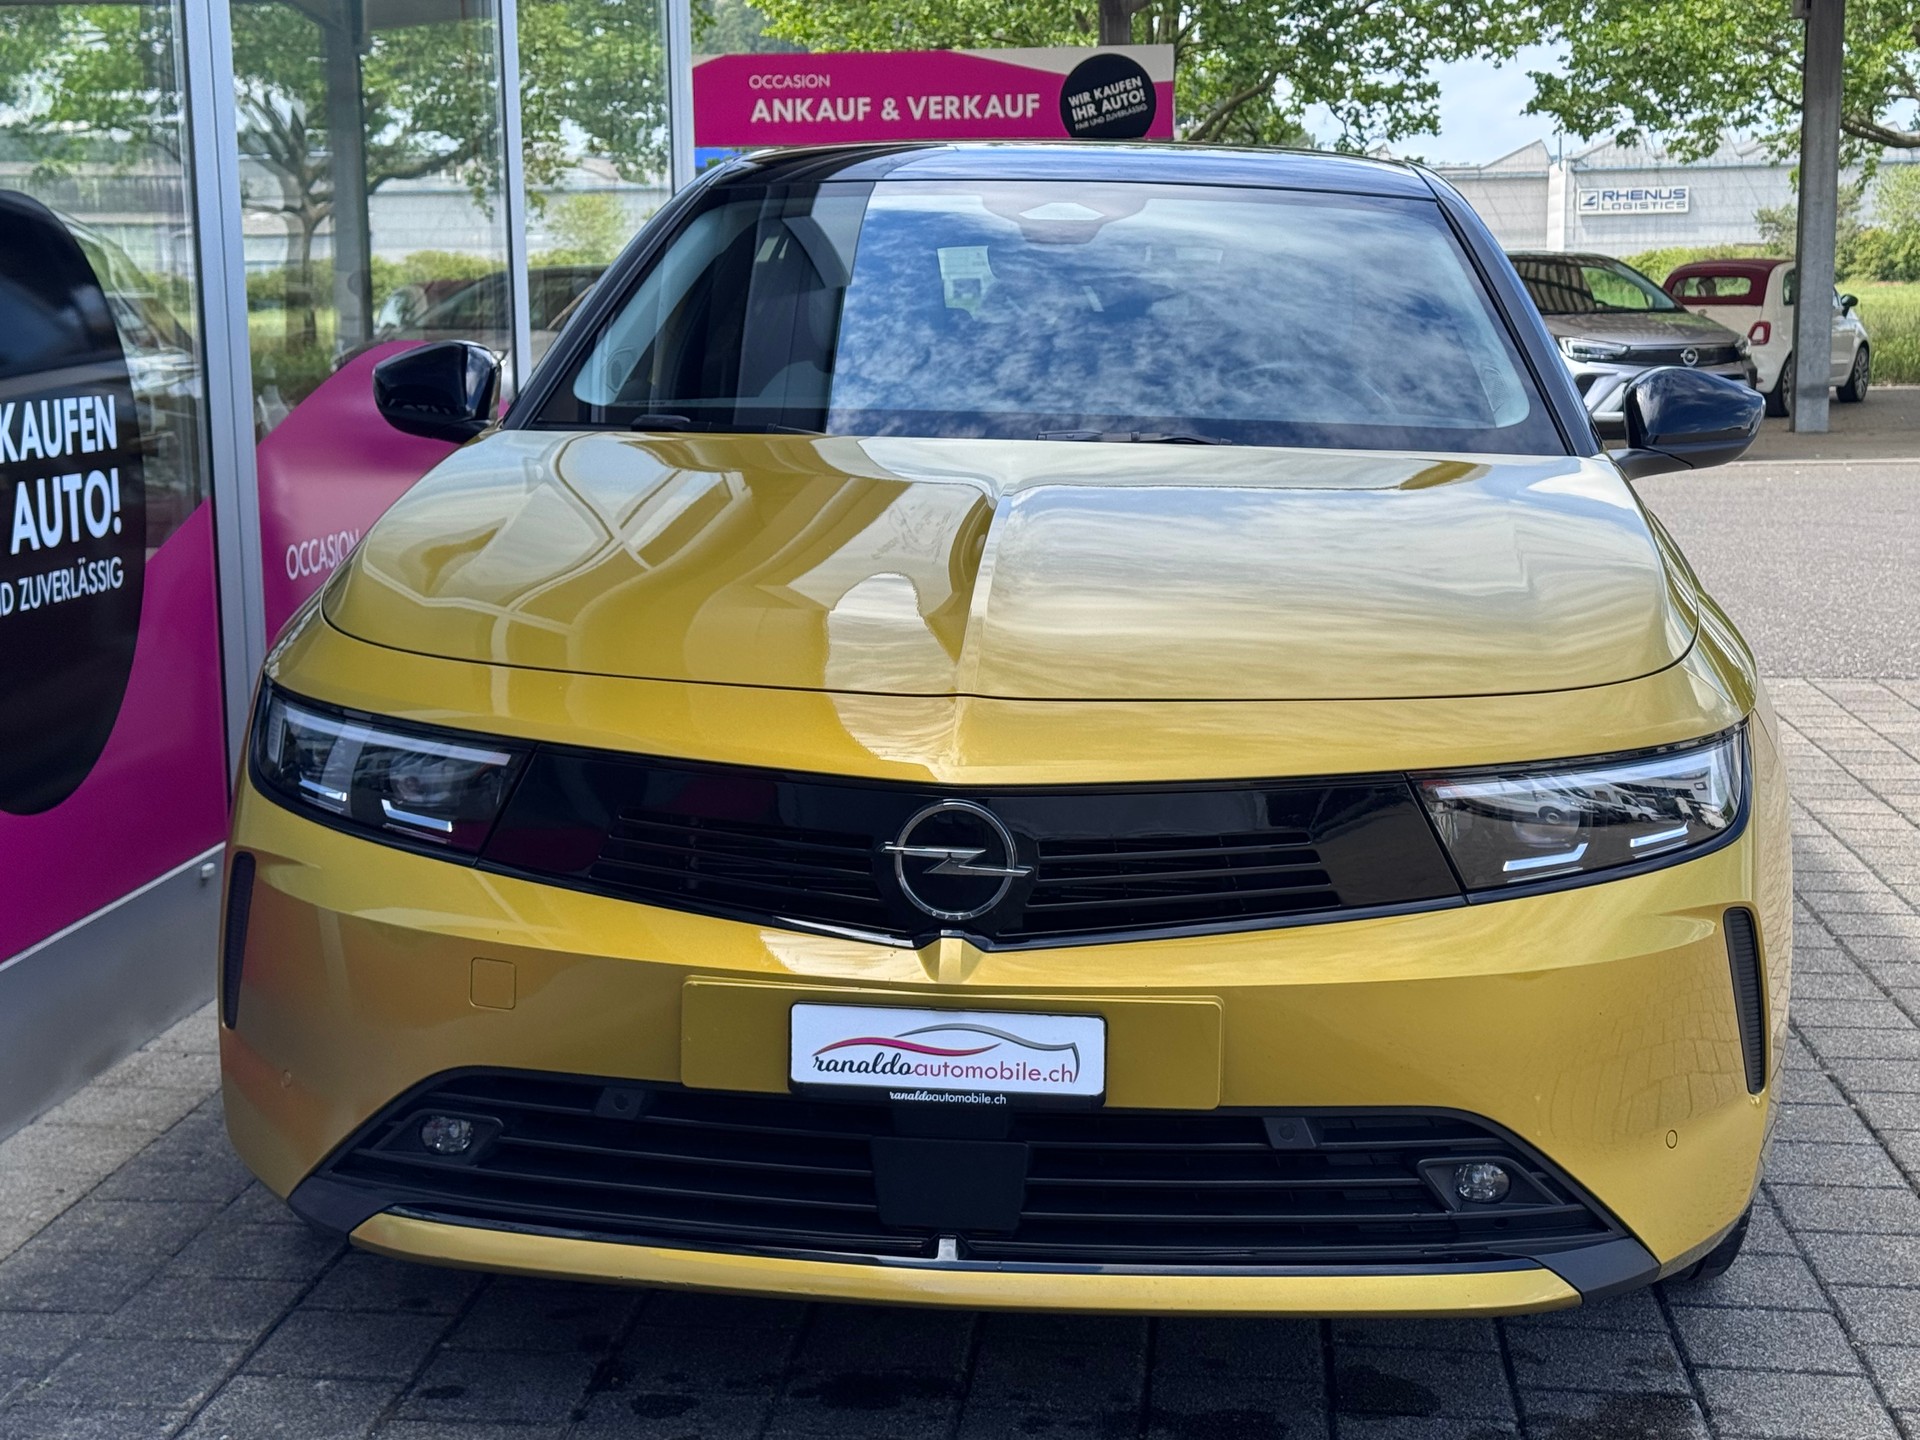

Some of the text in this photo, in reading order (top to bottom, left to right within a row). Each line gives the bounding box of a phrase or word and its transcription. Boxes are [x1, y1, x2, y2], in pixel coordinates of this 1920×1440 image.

[749, 74, 830, 89] OCCASION
[1068, 75, 1143, 107] WIR KAUFEN
[750, 93, 1040, 123] ANKAUF & VERKAUF
[1071, 88, 1146, 122] IHR AUTO!
[1601, 201, 1686, 211] LOGISTICS
[1602, 188, 1686, 201] RHENUS
[0, 394, 118, 464] KAUFEN
[10, 467, 123, 555] AUTO!
[18, 556, 124, 612] ZUVERLÄSSIG
[812, 1051, 1075, 1084] ranaldoautomobile.ch
[889, 1090, 1007, 1105] ranaldoautomobile.ch
